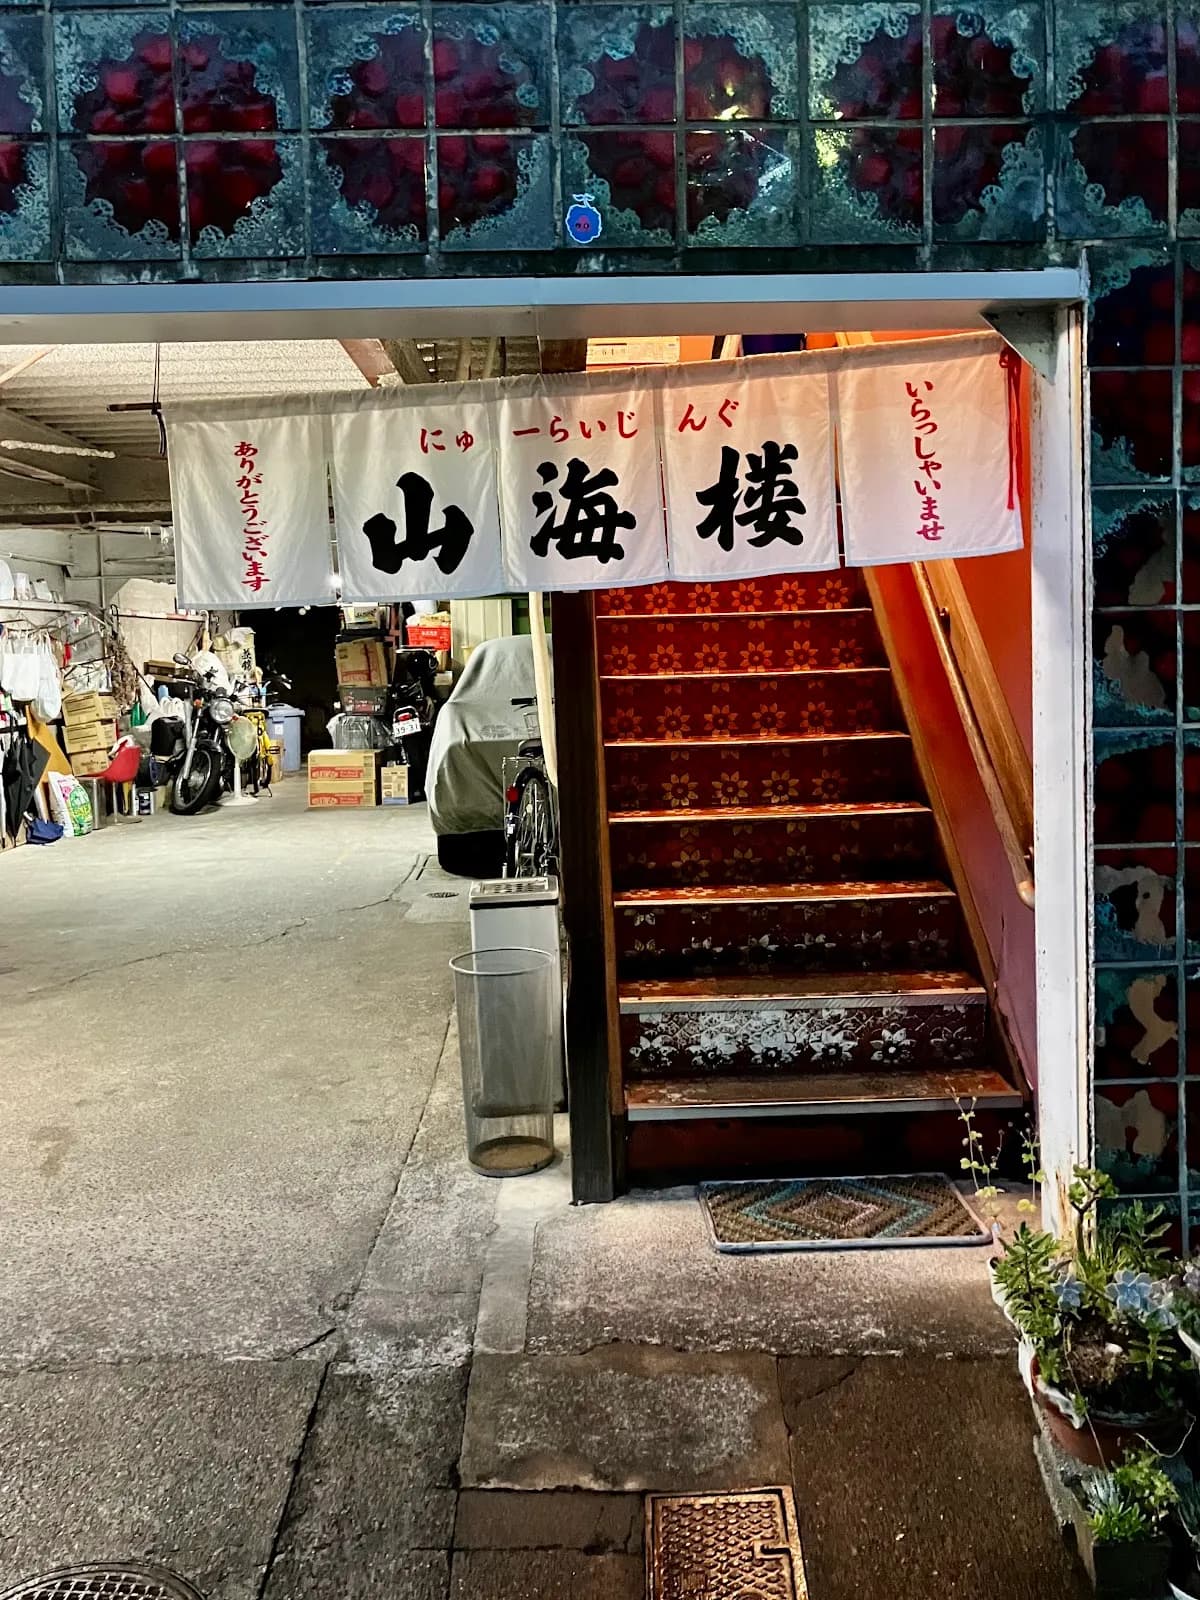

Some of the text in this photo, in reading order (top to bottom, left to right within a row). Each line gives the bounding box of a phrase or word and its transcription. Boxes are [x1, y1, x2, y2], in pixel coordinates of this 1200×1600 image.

[235, 441, 263, 592] ありがとうございます
[906, 380, 944, 541] いらっしゃいませ
